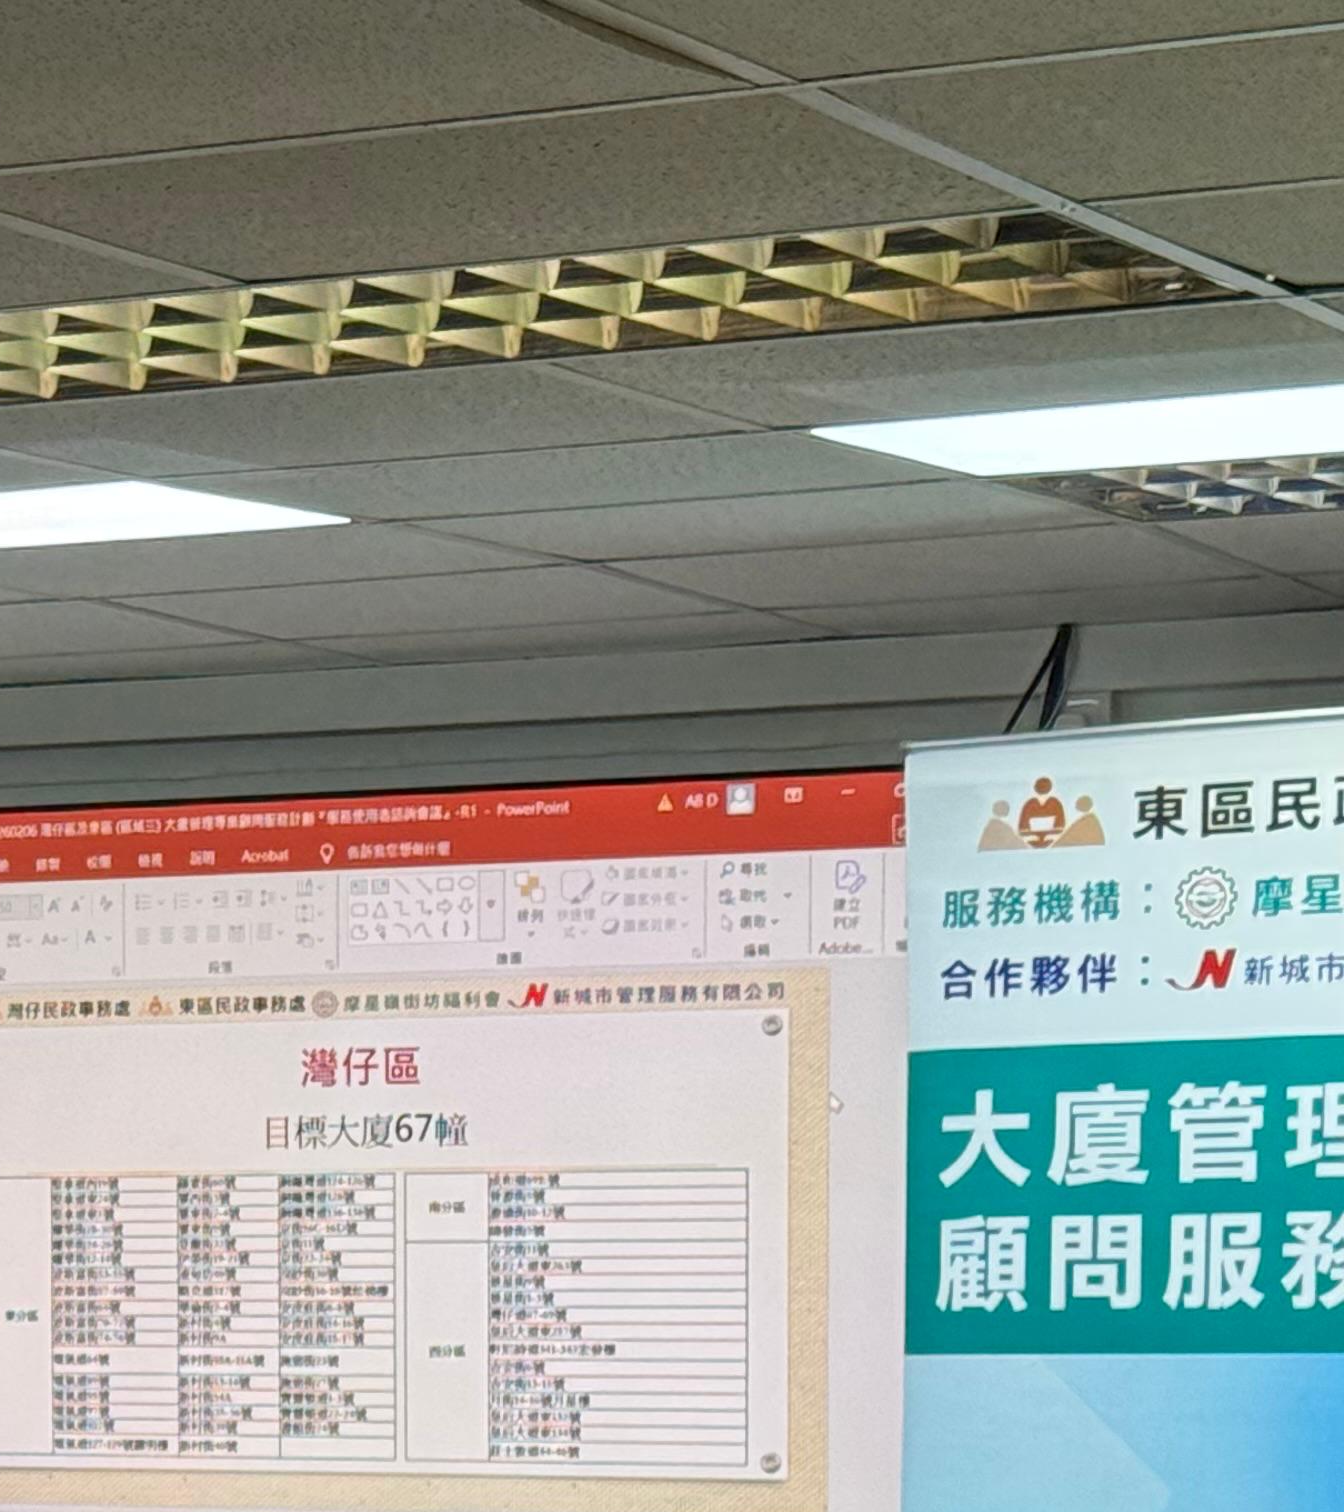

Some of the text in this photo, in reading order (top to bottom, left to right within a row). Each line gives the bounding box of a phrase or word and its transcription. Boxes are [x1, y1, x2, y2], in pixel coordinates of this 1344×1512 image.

[497, 800, 570, 818] PowerPoint
[1132, 777, 1344, 840] 東區民
[241, 848, 290, 864] Acrobat
[833, 917, 860, 930] PDF
[343, 990, 501, 1012] 摩星嶺街坊福利會
[553, 982, 785, 1005] 新城市管理服務有限公司
[7, 1000, 131, 1019] 灣仔民政事務處
[180, 995, 305, 1015] 東區民政事務處
[301, 1046, 420, 1088] 灣仔區
[266, 1113, 469, 1150] 目標大廈67幢
[938, 1080, 1344, 1188] 大廈管理
[936, 1210, 1344, 1312] 顧問服務
